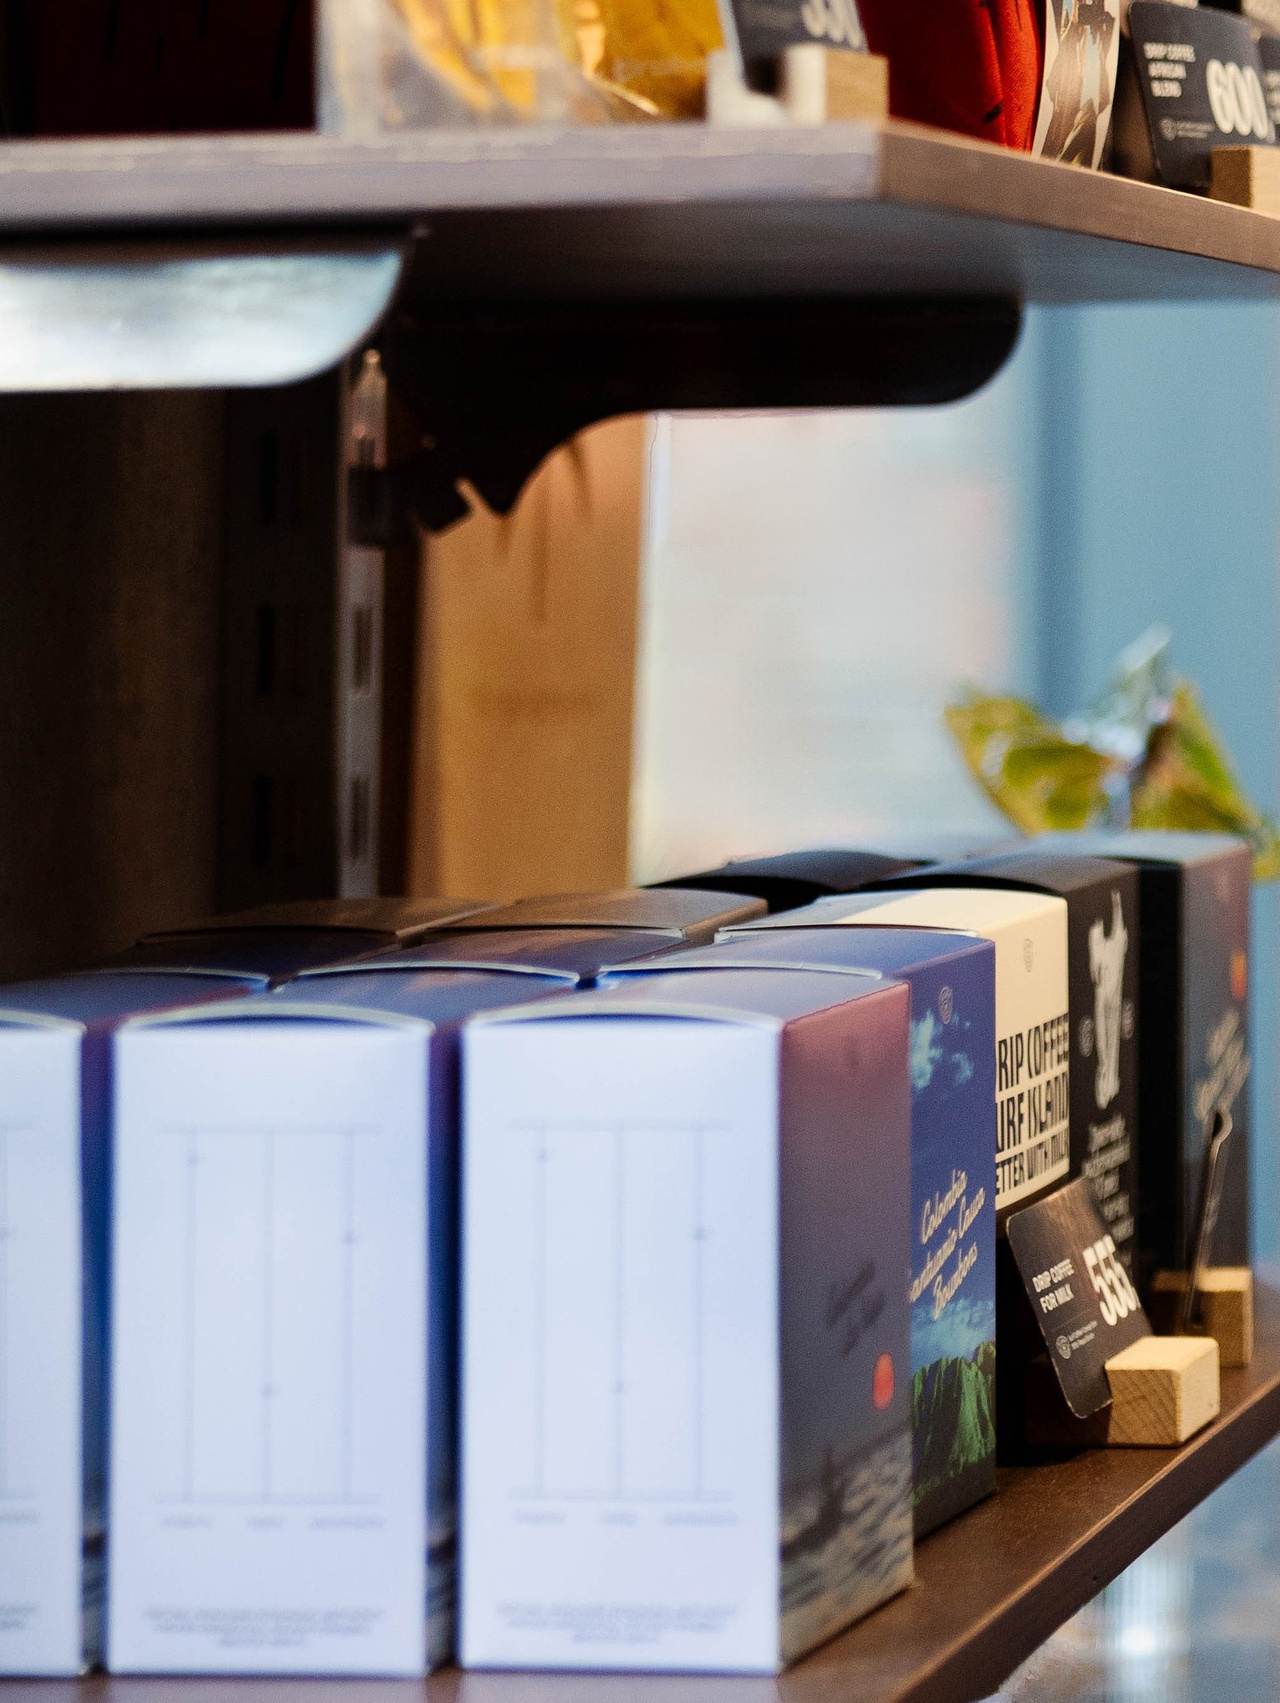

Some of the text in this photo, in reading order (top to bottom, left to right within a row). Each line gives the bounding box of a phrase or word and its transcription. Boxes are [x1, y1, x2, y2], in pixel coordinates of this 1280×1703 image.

[998, 1013, 1069, 1092] RIP COFFEE
[996, 1092, 1025, 1154] URF
[996, 1152, 1026, 1196] ETTER
[922, 1169, 968, 1245] Colombia
[1040, 1292, 1059, 1314] FOR
